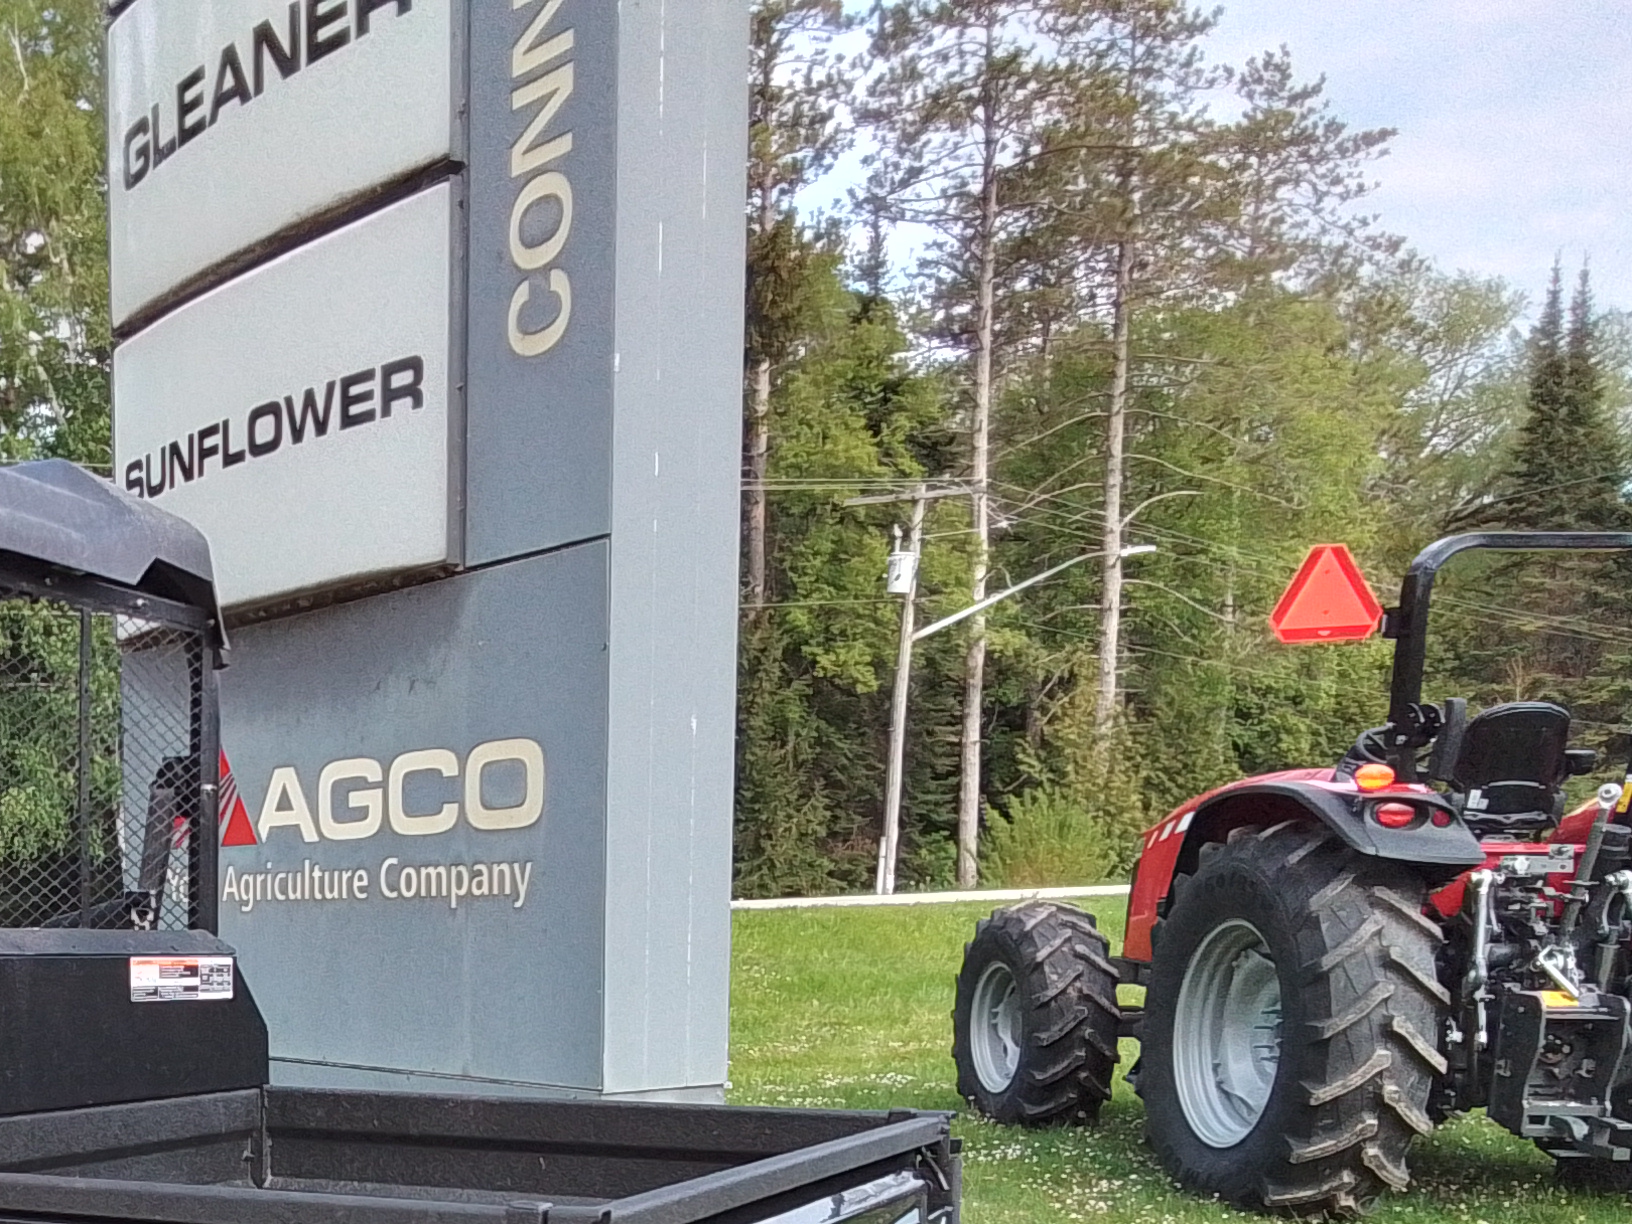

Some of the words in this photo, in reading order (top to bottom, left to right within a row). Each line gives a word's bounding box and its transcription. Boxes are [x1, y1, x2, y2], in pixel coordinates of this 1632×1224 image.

[124, 354, 425, 500] SUNFLOWER
[257, 737, 545, 844] AGCO
[221, 858, 369, 912] Agriculture
[379, 856, 533, 909] Company
